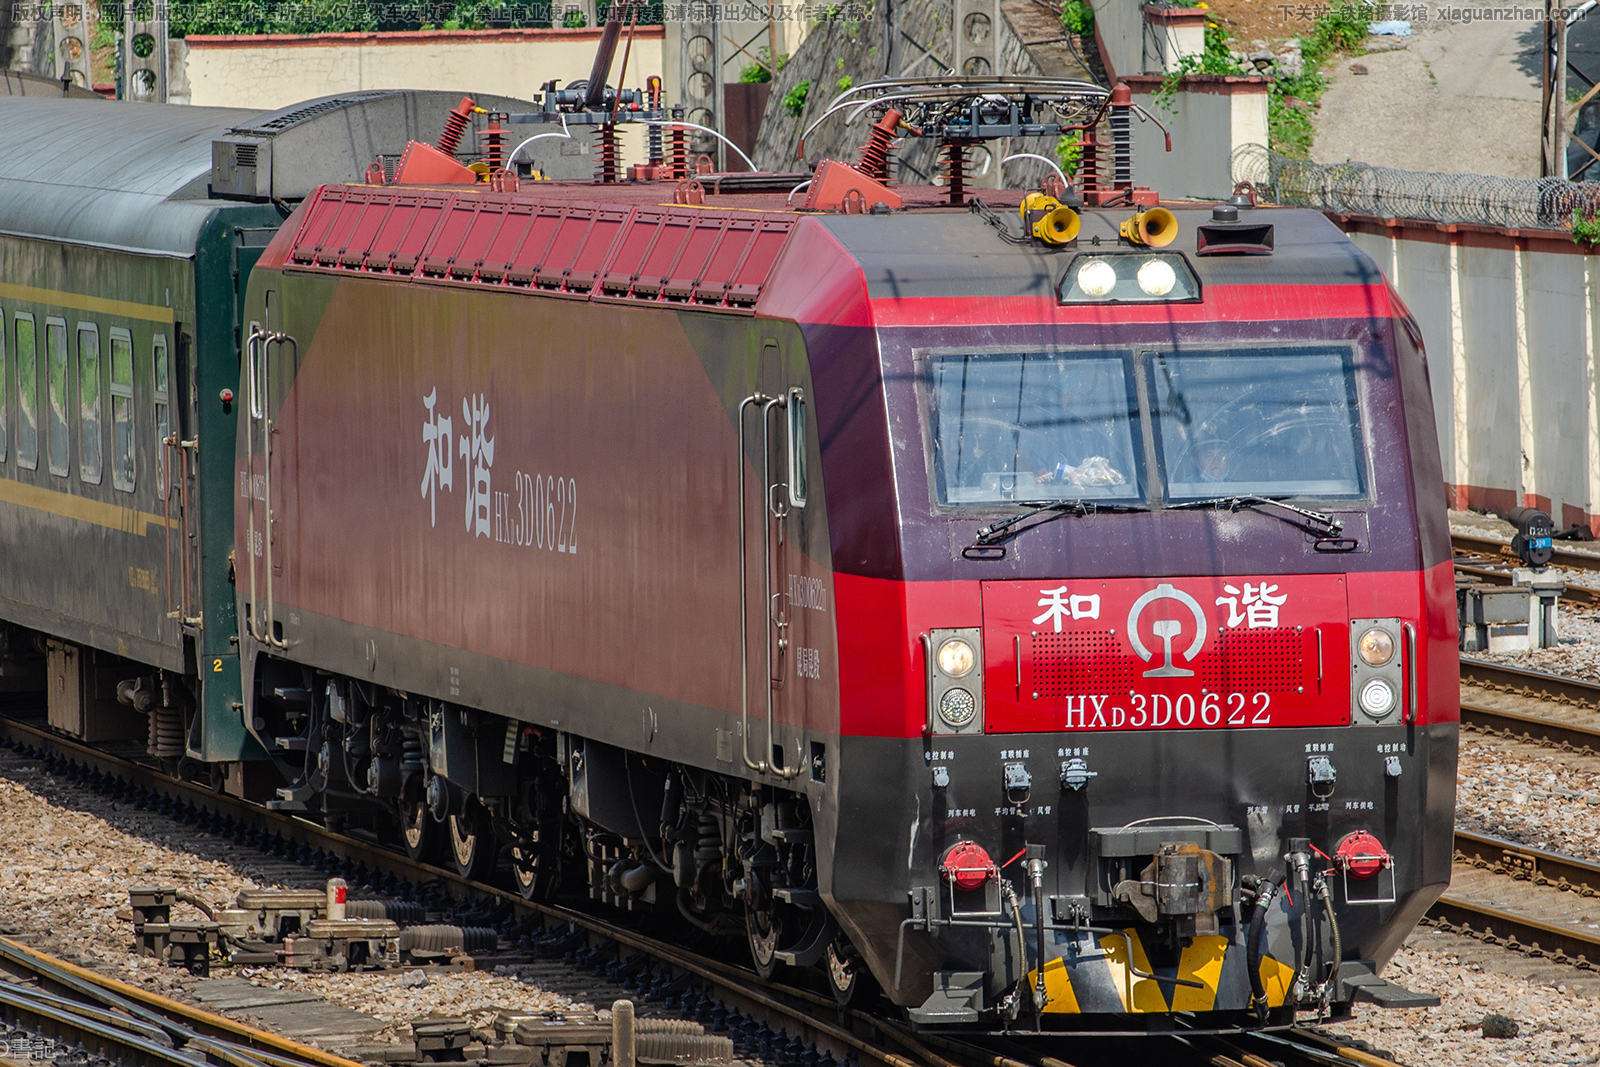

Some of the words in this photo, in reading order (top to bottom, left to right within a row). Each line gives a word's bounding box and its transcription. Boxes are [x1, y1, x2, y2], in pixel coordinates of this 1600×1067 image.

[421, 385, 495, 539] 和谐
[494, 470, 578, 555] HXD3D0622
[213, 658, 223, 672] 2
[1065, 692, 1273, 729] HXD3D0622
